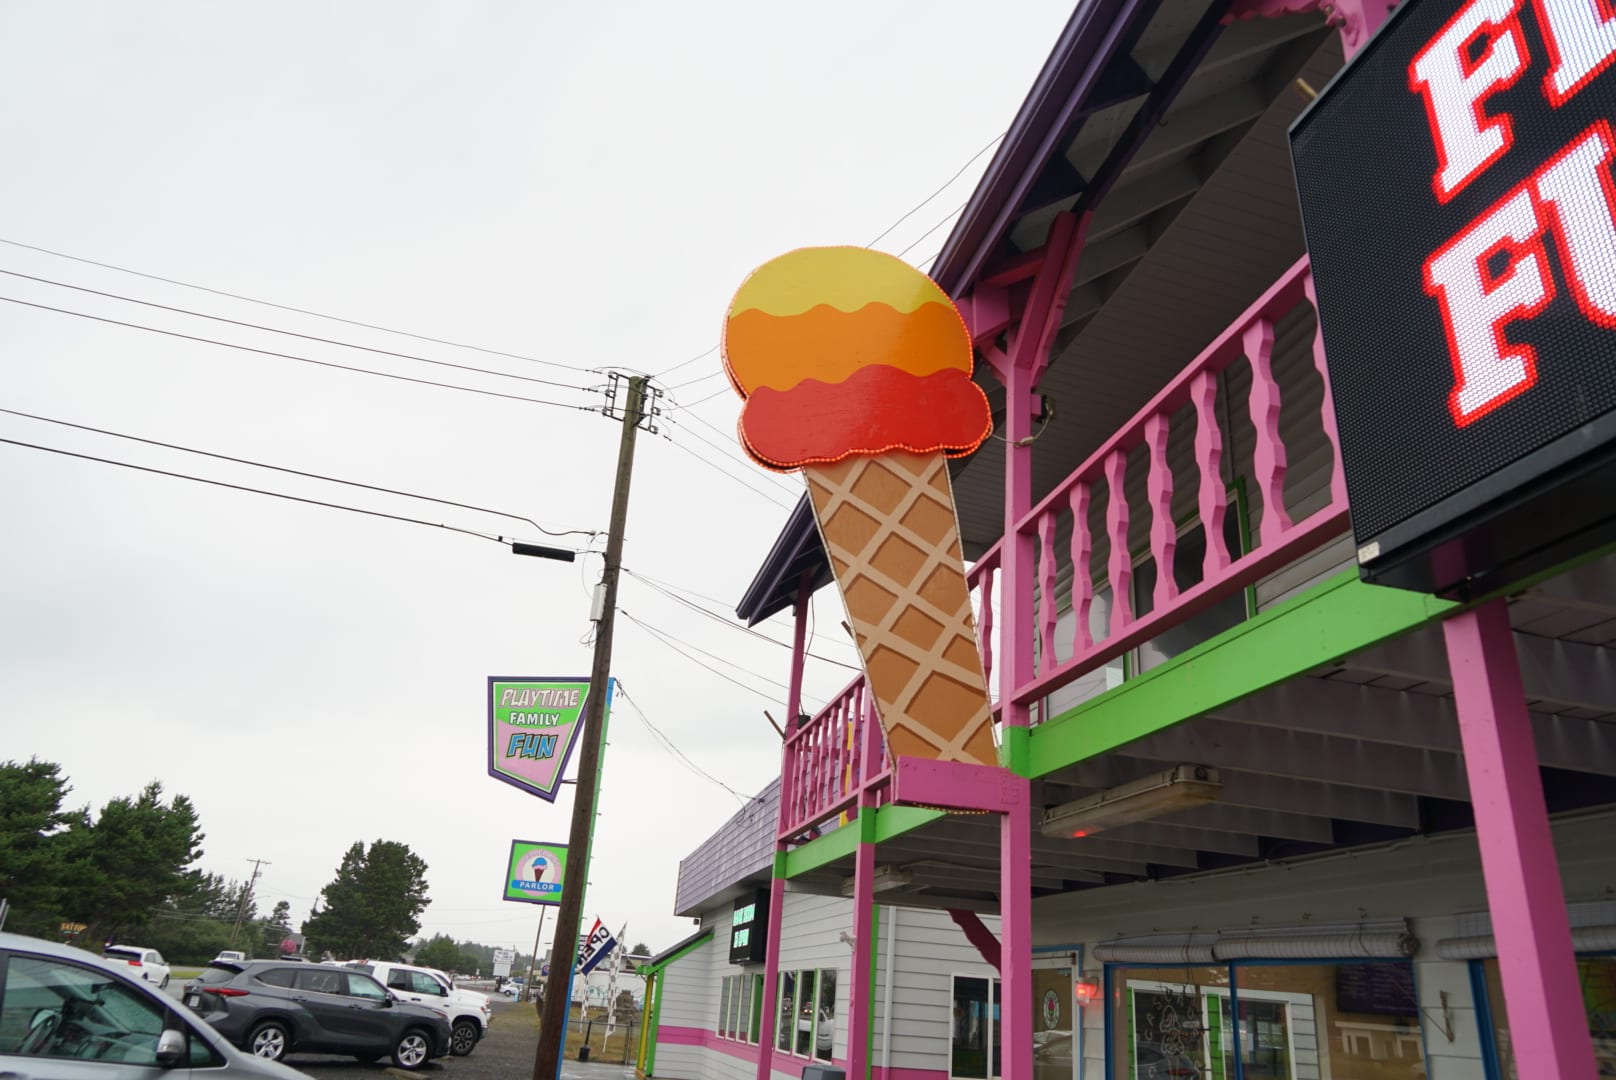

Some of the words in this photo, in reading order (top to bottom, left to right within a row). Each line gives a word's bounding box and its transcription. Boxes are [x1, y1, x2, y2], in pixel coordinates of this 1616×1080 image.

[500, 687, 581, 709] PLAYTIME
[509, 711, 561, 727] FAMILY
[506, 733, 559, 760] FUN
[519, 881, 555, 892] PARLOR
